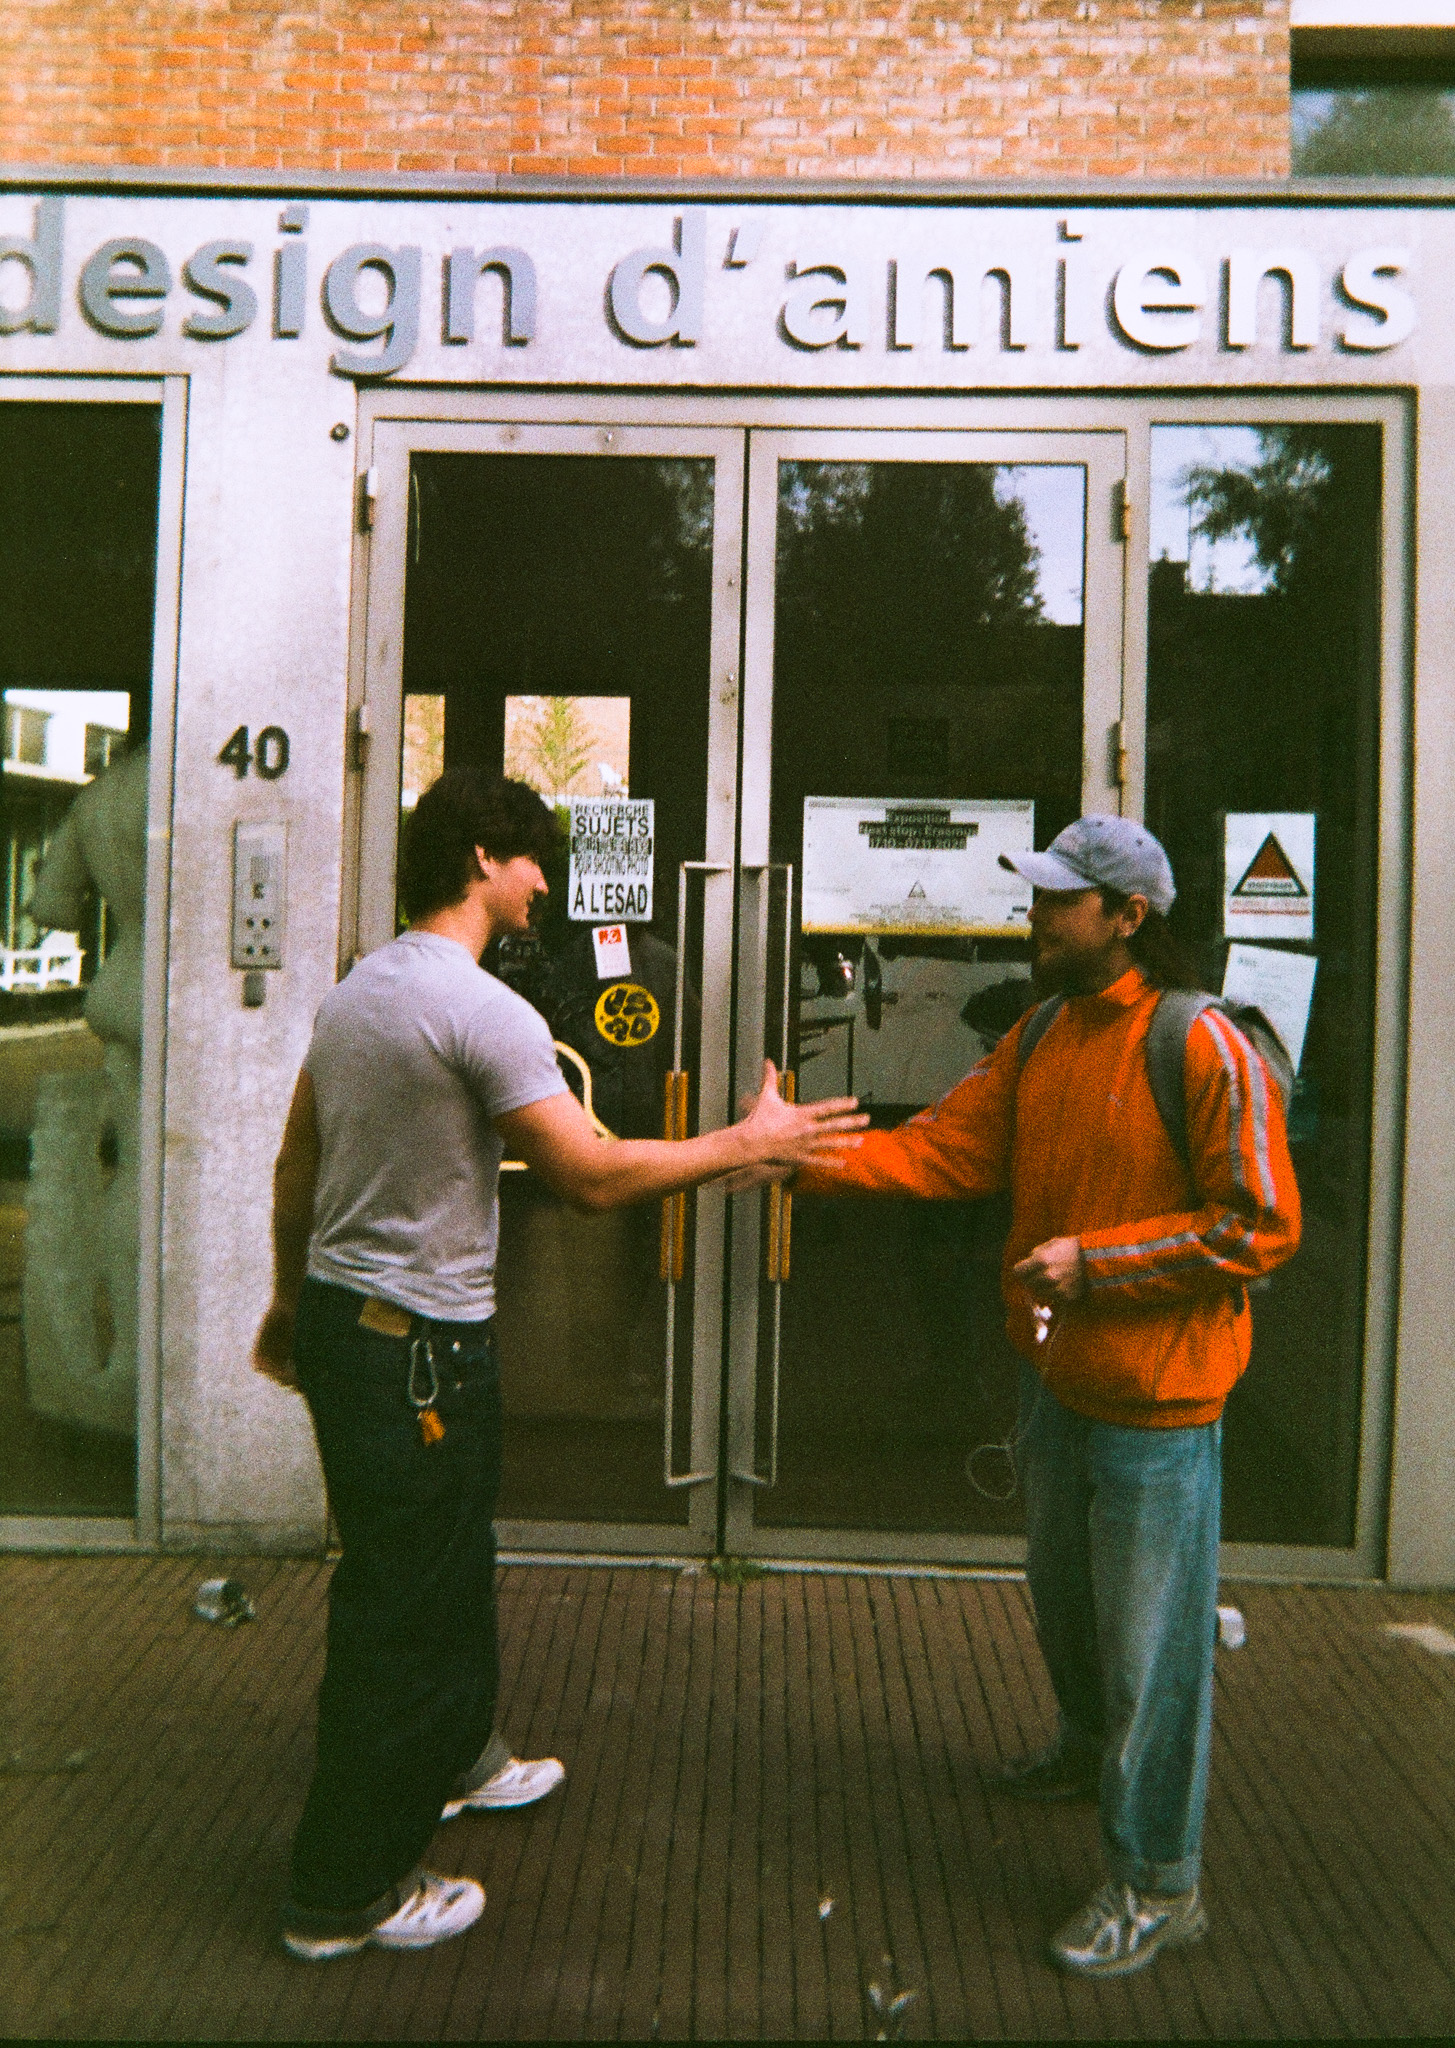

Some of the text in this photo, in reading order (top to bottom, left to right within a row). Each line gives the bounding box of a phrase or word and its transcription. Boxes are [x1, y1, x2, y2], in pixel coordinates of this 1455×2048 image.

[0, 195, 1417, 377] design d'amiens
[217, 725, 290, 781] 40
[575, 804, 649, 816] RECHERCHE
[575, 815, 650, 837] SUJETS
[590, 883, 648, 914] L'ESAD
